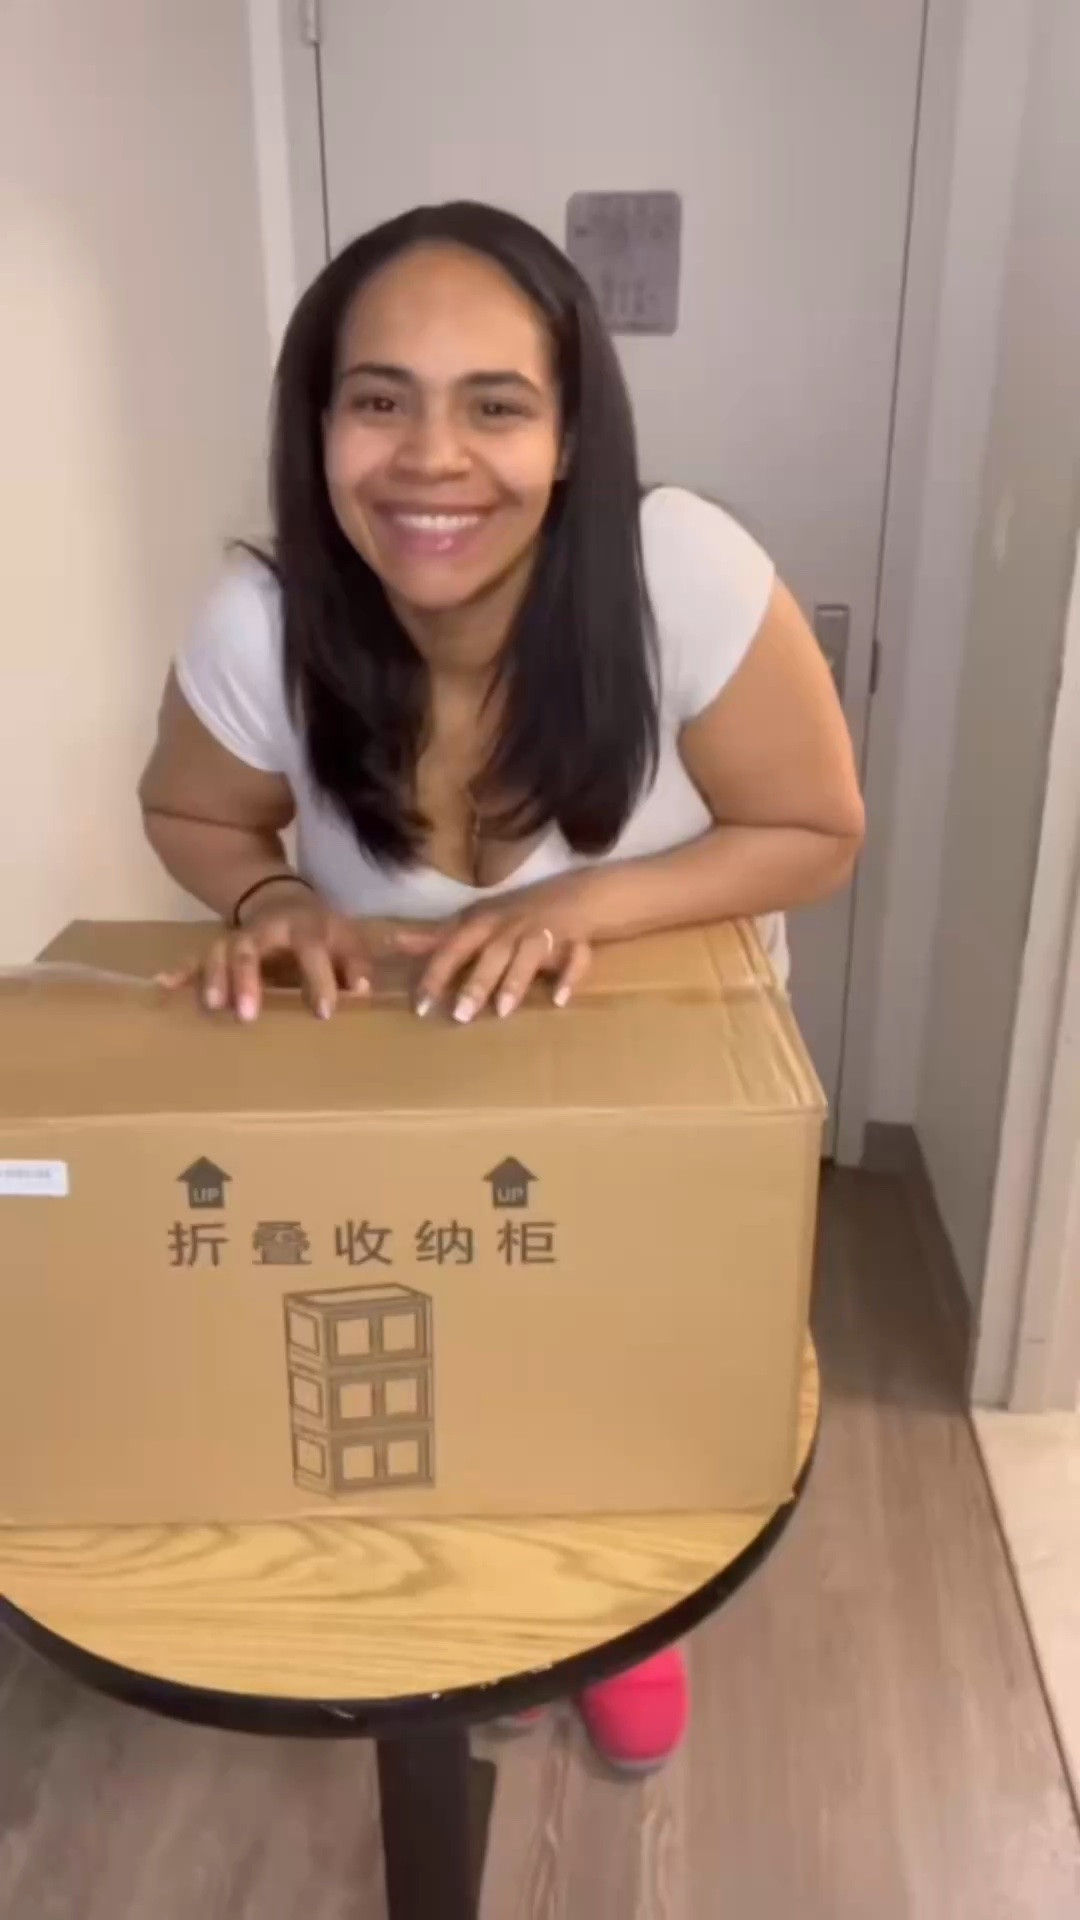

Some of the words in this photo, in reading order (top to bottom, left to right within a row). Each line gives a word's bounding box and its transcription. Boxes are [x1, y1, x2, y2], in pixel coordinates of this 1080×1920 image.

[193, 1187, 220, 1203] UP
[497, 1187, 525, 1203] UP
[167, 1219, 558, 1267] 折叠收纳柜
